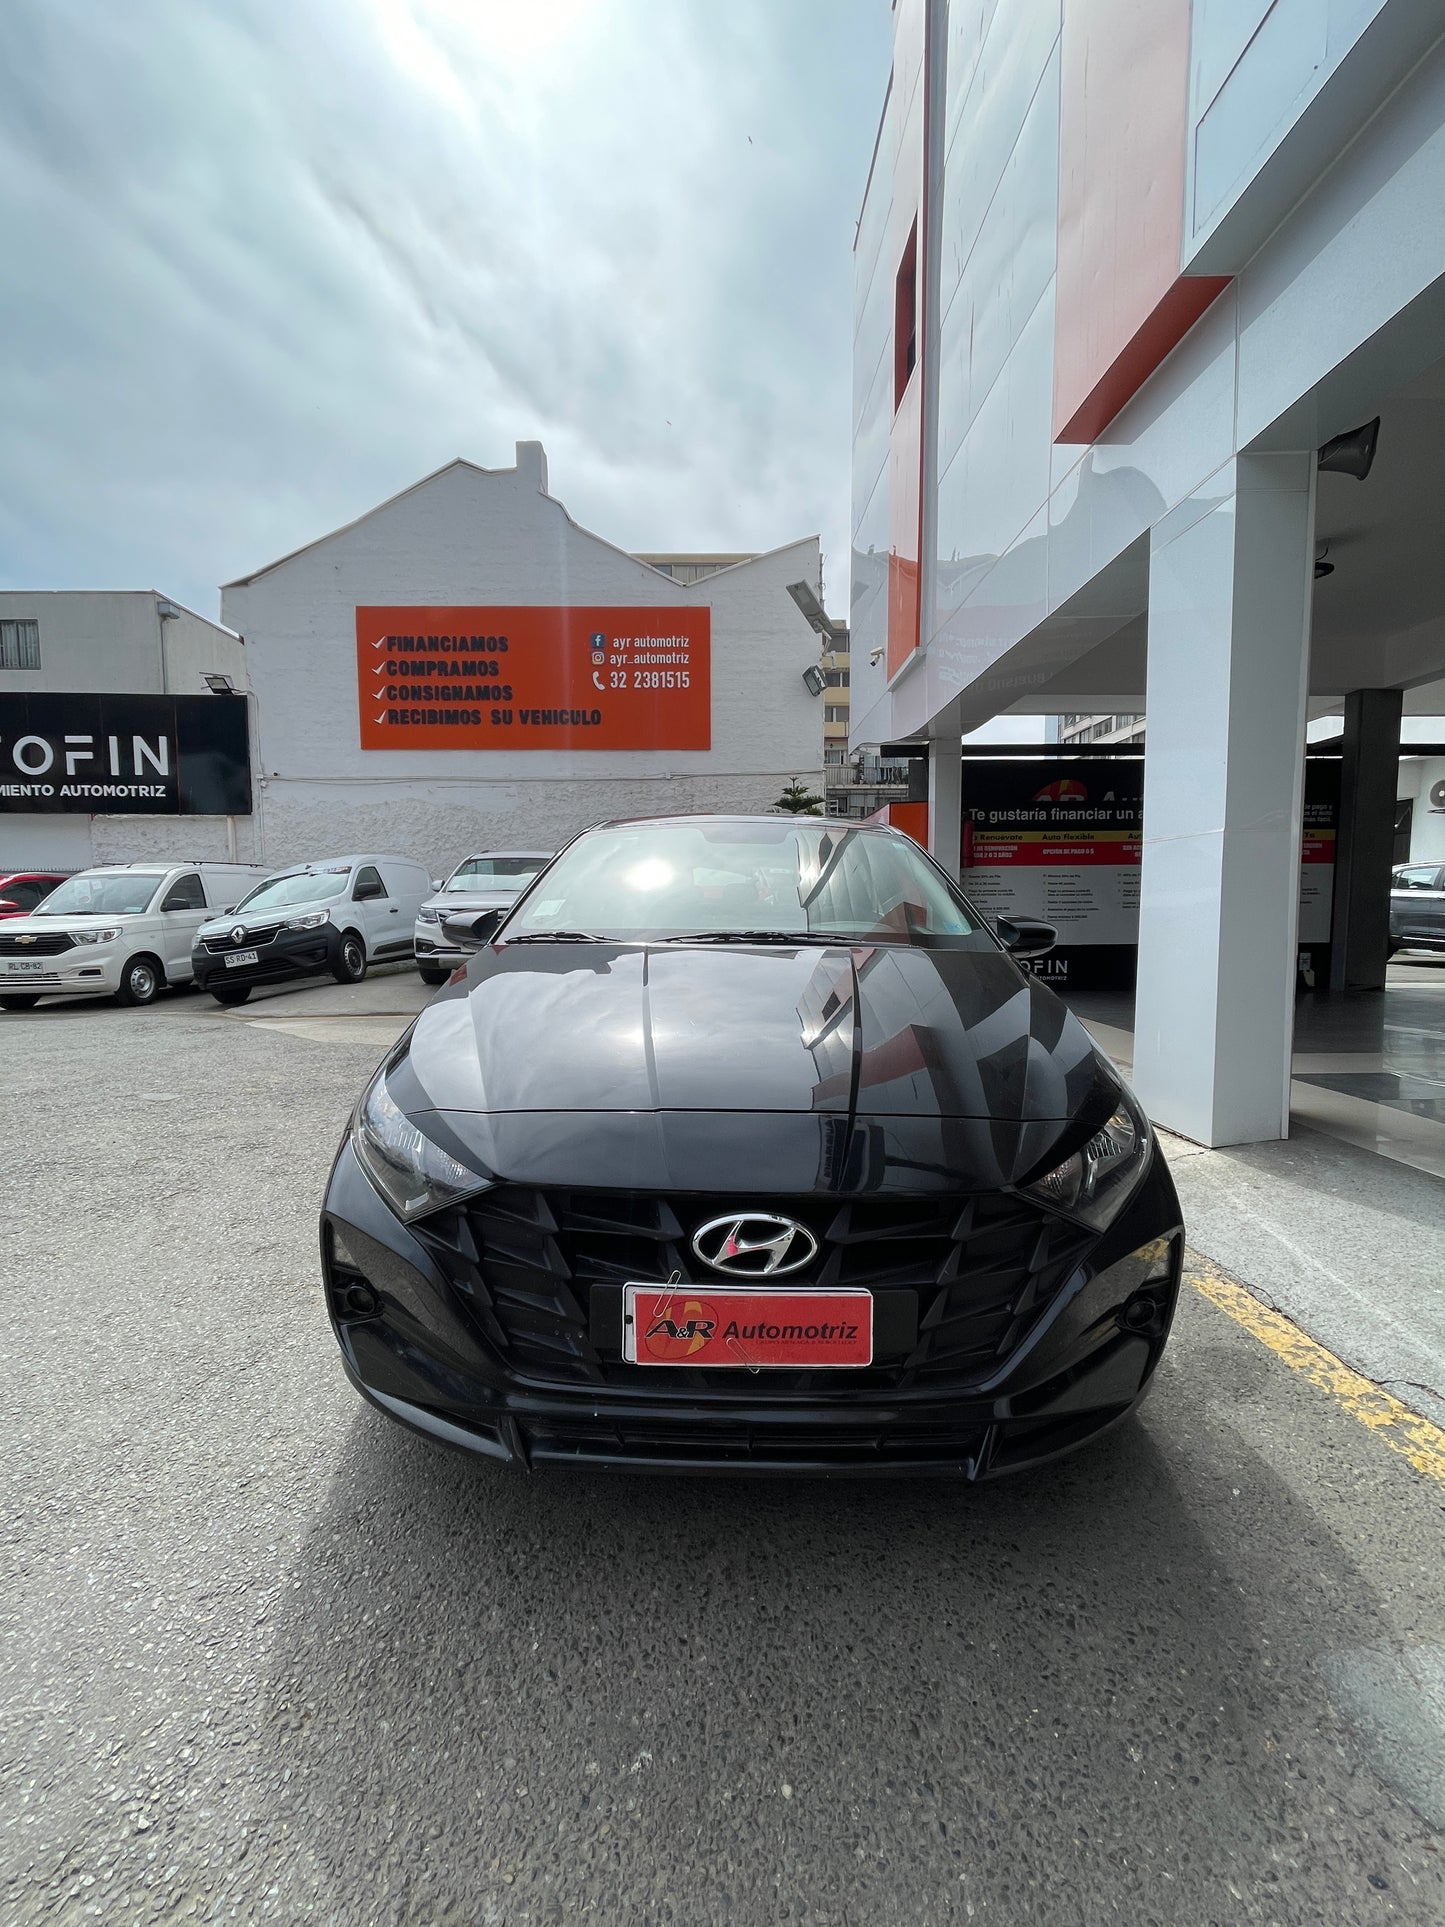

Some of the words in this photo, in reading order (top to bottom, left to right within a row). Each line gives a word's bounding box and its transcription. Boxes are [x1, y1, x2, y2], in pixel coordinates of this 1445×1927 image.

[386, 636, 508, 651] FINANCIAMOS
[613, 638, 631, 650] ayr
[634, 635, 689, 647] automotriz
[610, 652, 689, 667] ayr_automotriz
[386, 660, 499, 676] COMPRAMOS
[610, 671, 627, 688] 32
[634, 671, 690, 688] 2381515
[386, 685, 513, 700] CONSIGNAMOS
[388, 709, 482, 725] RECIBIMOS
[491, 709, 513, 724] SU
[519, 708, 602, 725] VEHICULO
[59, 784, 166, 797] AUTOMOTRIZ
[989, 807, 1047, 824] gustaría
[1050, 807, 1113, 821] financiar
[1115, 809, 1134, 820] un
[645, 1319, 716, 1340] A&R
[722, 1320, 859, 1339] Automotriz
